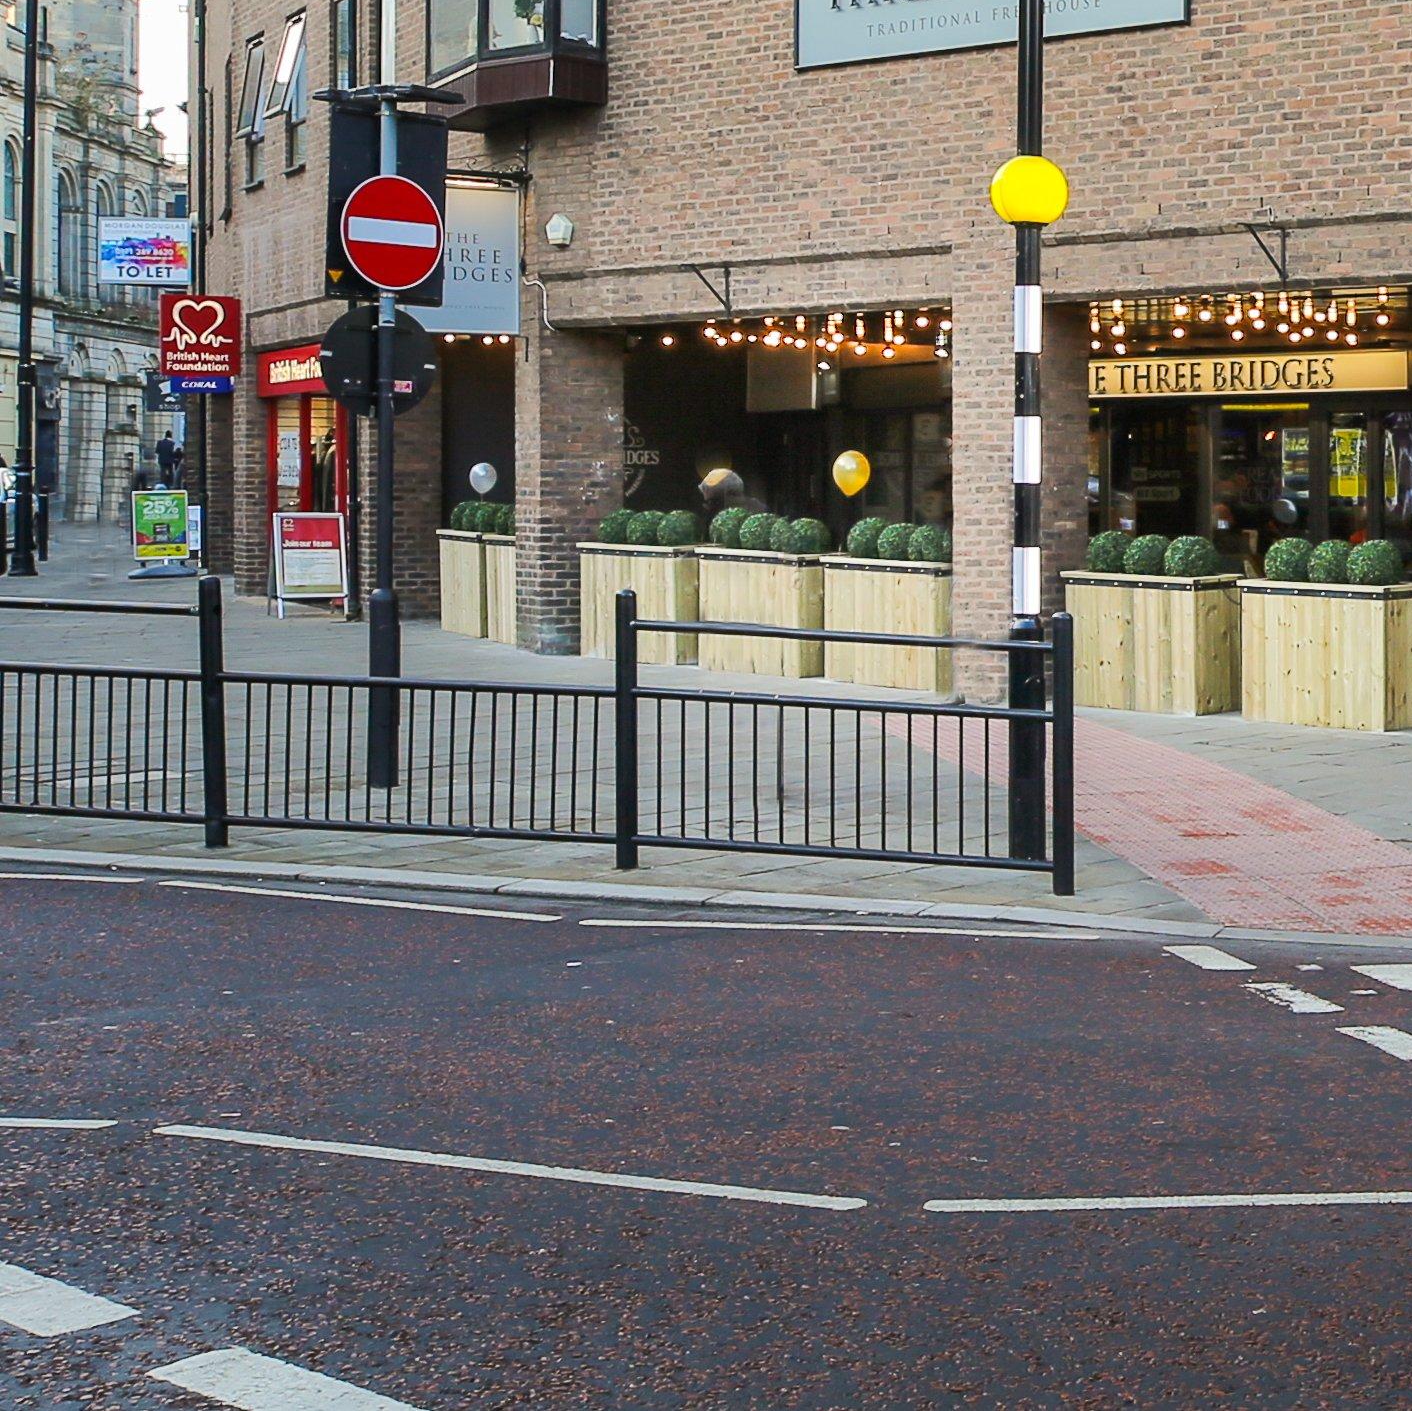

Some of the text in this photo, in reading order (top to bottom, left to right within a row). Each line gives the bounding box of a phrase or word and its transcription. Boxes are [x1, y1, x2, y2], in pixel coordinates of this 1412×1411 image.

[867, 10, 981, 37] TRADITIONAL
[992, 5, 1019, 21] FRE
[446, 232, 480, 244] THE
[444, 248, 502, 264] HREE
[116, 266, 172, 278] TO LET
[167, 351, 229, 362] British Heart
[166, 361, 230, 372] Foundation
[1114, 361, 1202, 394] THREE
[1212, 357, 1335, 392] BRIDGES
[181, 381, 217, 389] CORAL
[143, 499, 179, 515] 25%
[312, 540, 333, 548] team
